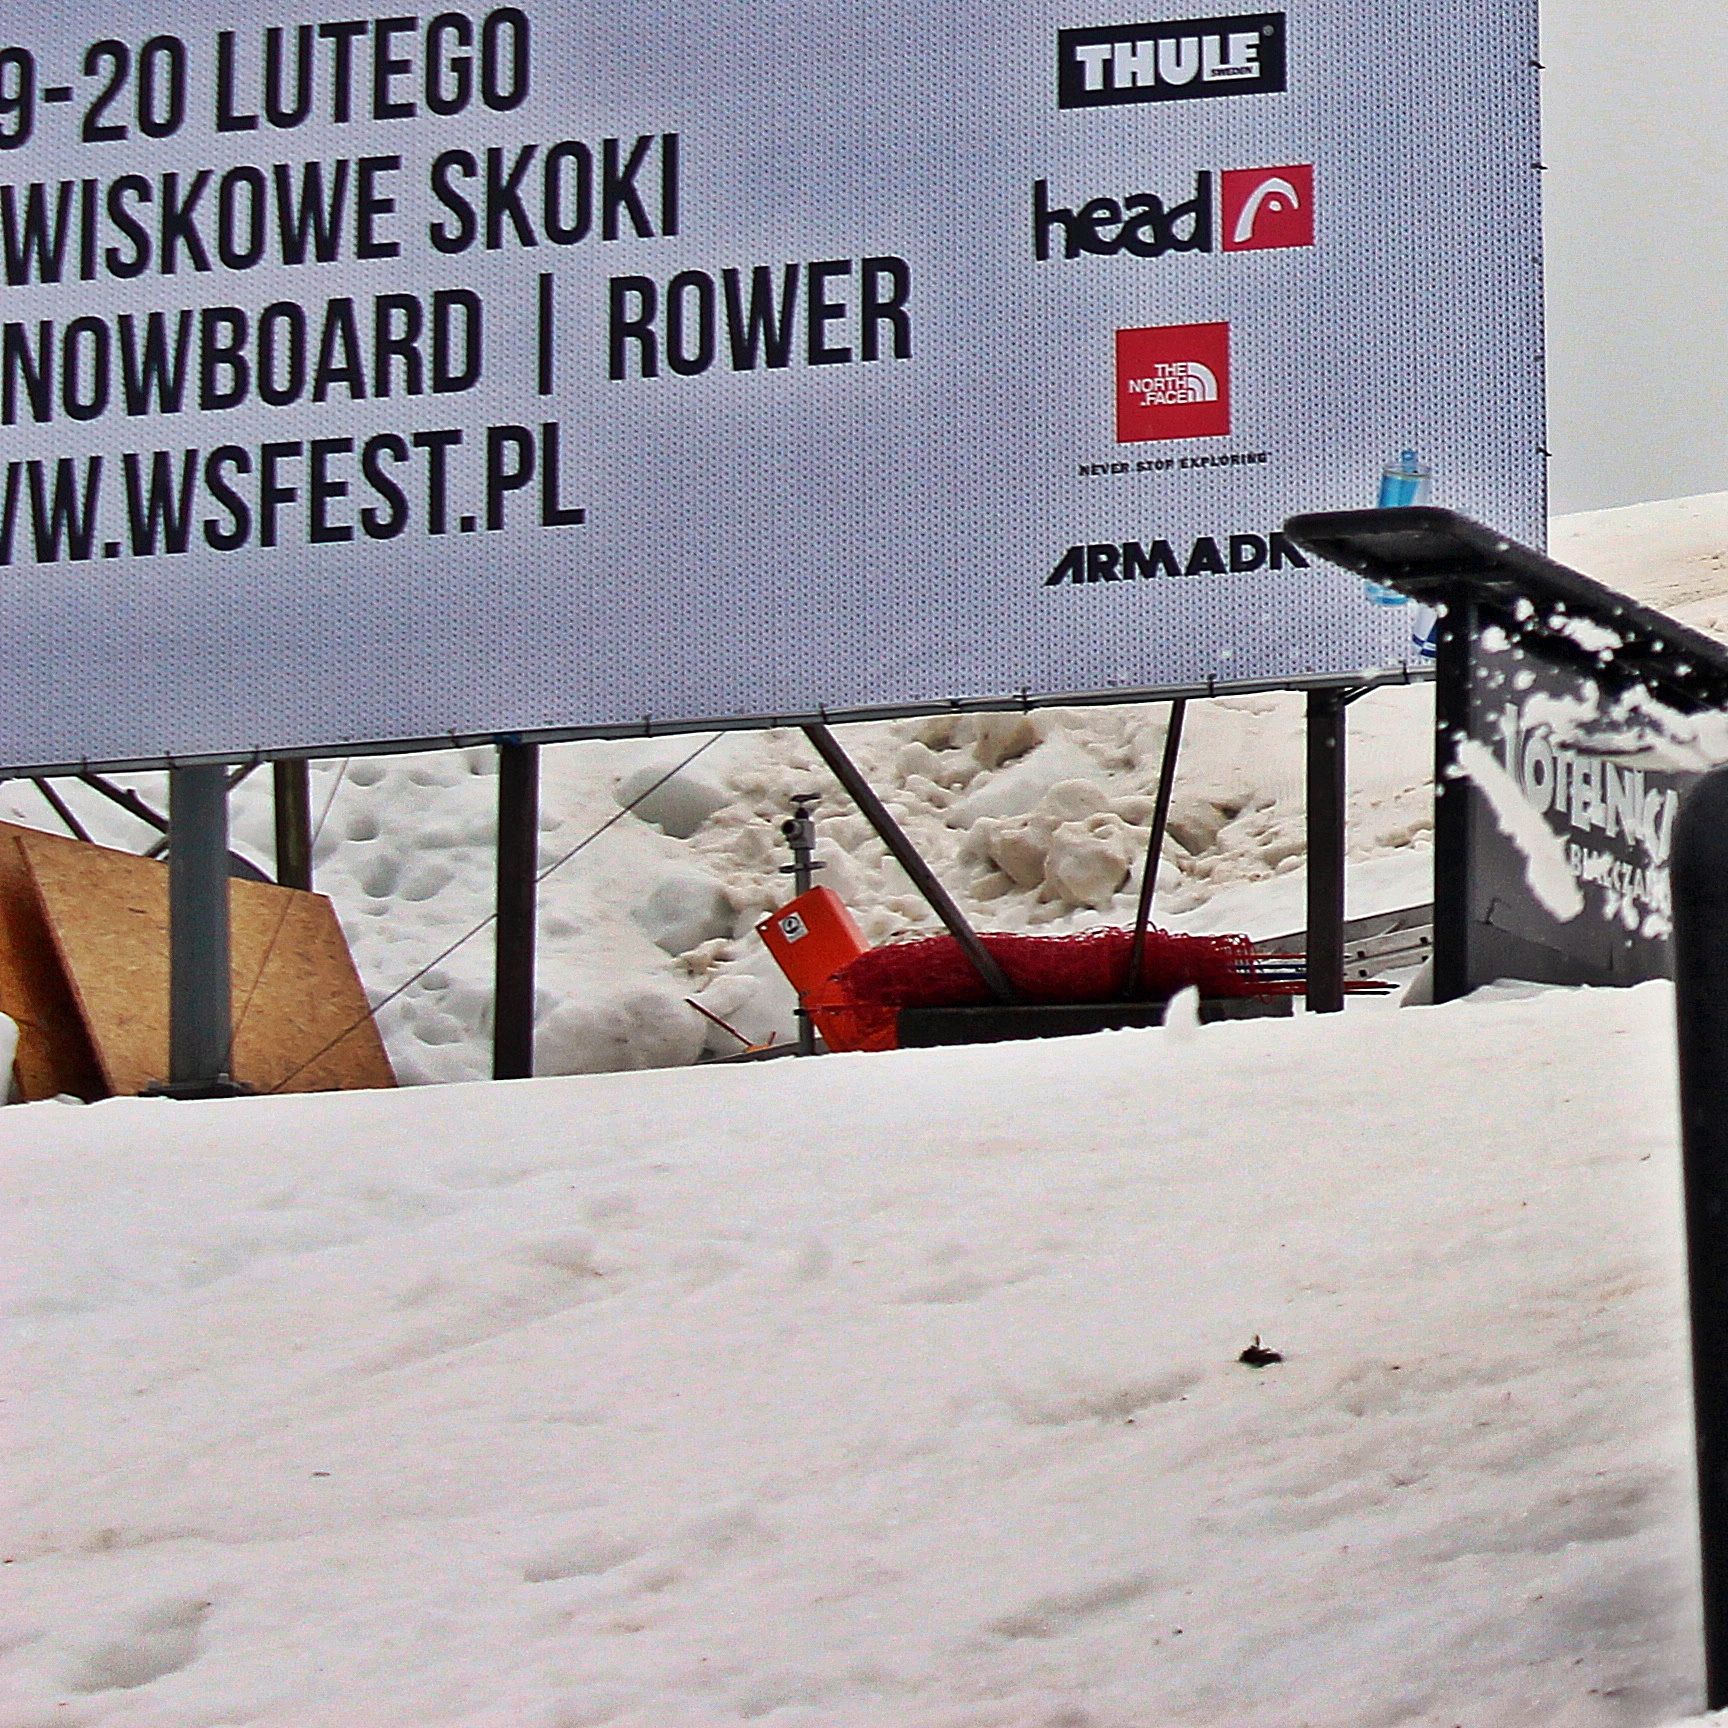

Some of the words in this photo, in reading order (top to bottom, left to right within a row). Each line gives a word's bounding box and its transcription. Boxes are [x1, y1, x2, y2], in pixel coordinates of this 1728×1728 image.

[216, 7, 532, 133] LUTEGO
[1075, 31, 1262, 92] THULE
[0, 155, 402, 286] WISKOWE
[430, 132, 681, 256] SKOKI
[1032, 170, 1214, 262] head
[0, 288, 485, 426] NOWBOARD
[609, 253, 912, 381] ROWER
[1154, 362, 1188, 378] THE
[1129, 377, 1188, 394] NORTH
[1078, 461, 1130, 477] NEVER
[1136, 458, 1174, 474] STOP
[1180, 453, 1268, 471] EXPLORING
